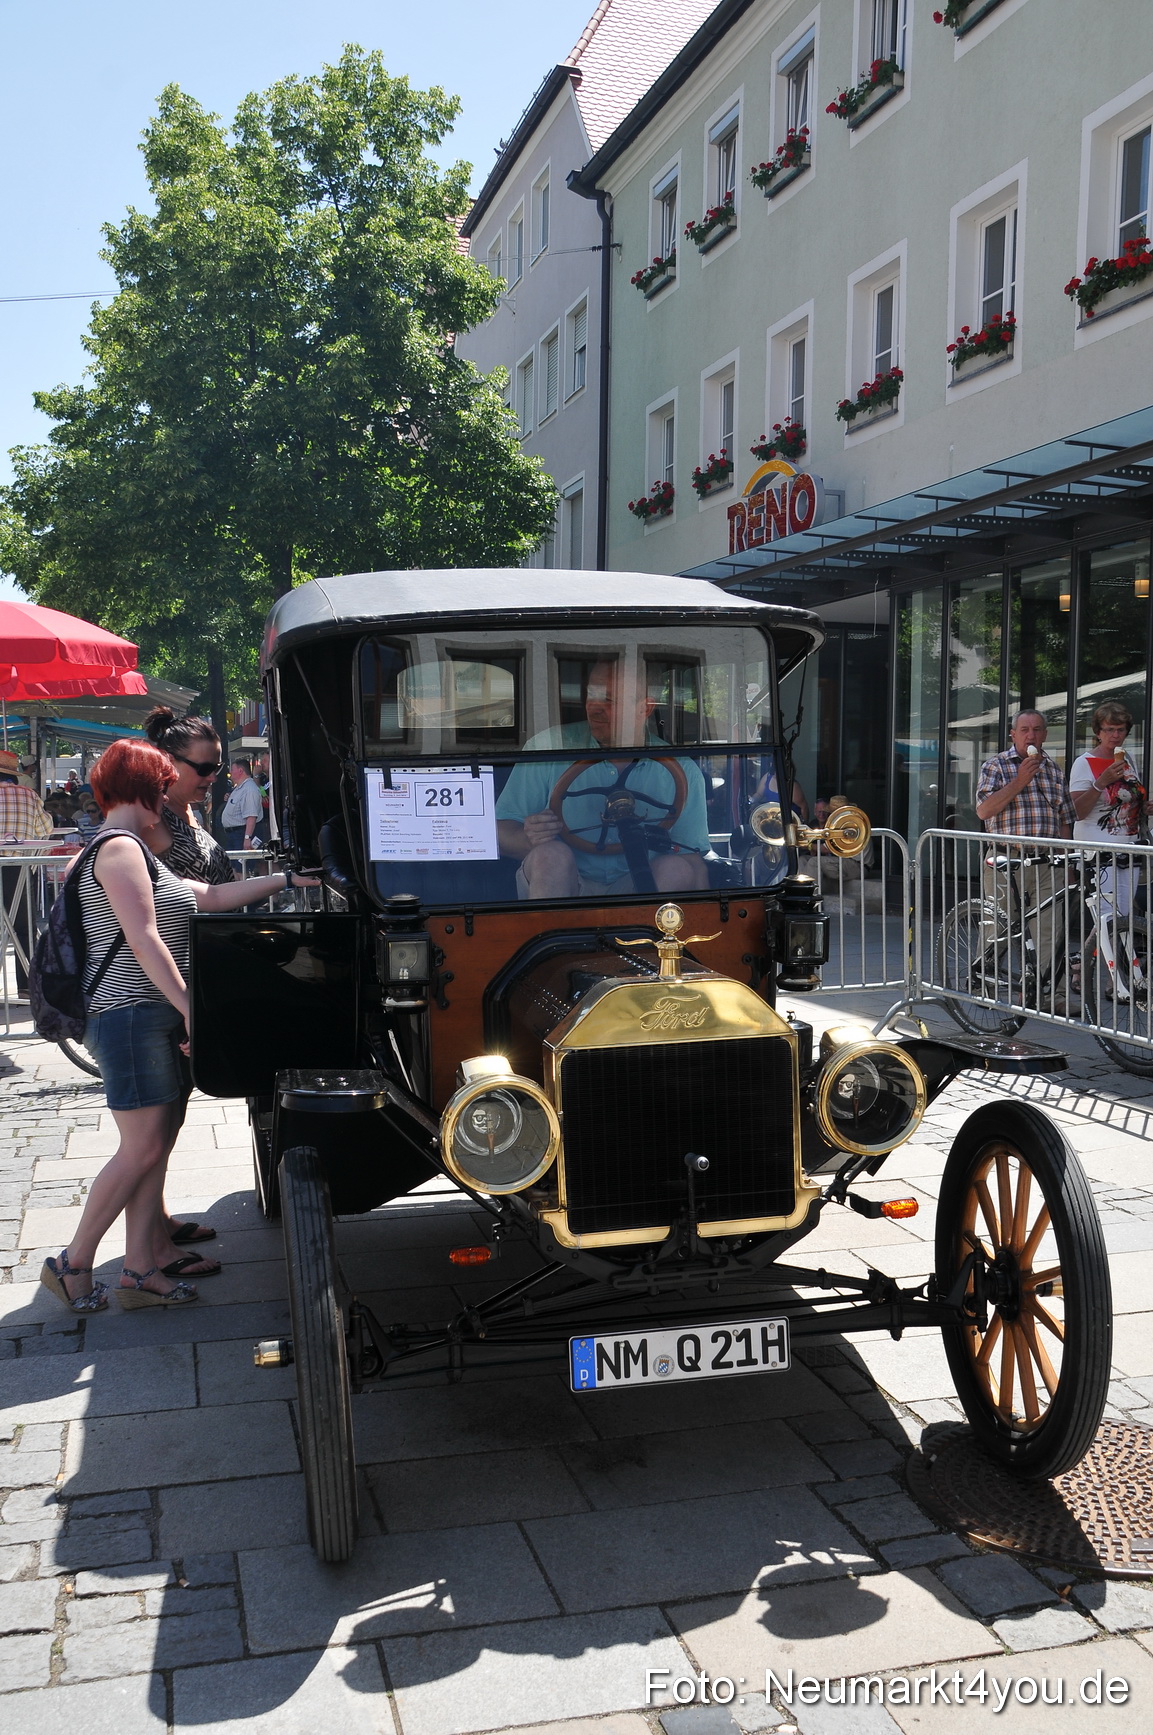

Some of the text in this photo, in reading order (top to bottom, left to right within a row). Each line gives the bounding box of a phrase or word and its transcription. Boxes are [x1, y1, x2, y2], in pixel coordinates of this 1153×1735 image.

[727, 473, 818, 556] RENO
[425, 787, 465, 807] 281
[640, 994, 710, 1031] Ford
[596, 1324, 786, 1382] NM Q 21H
[579, 1369, 589, 1381] D
